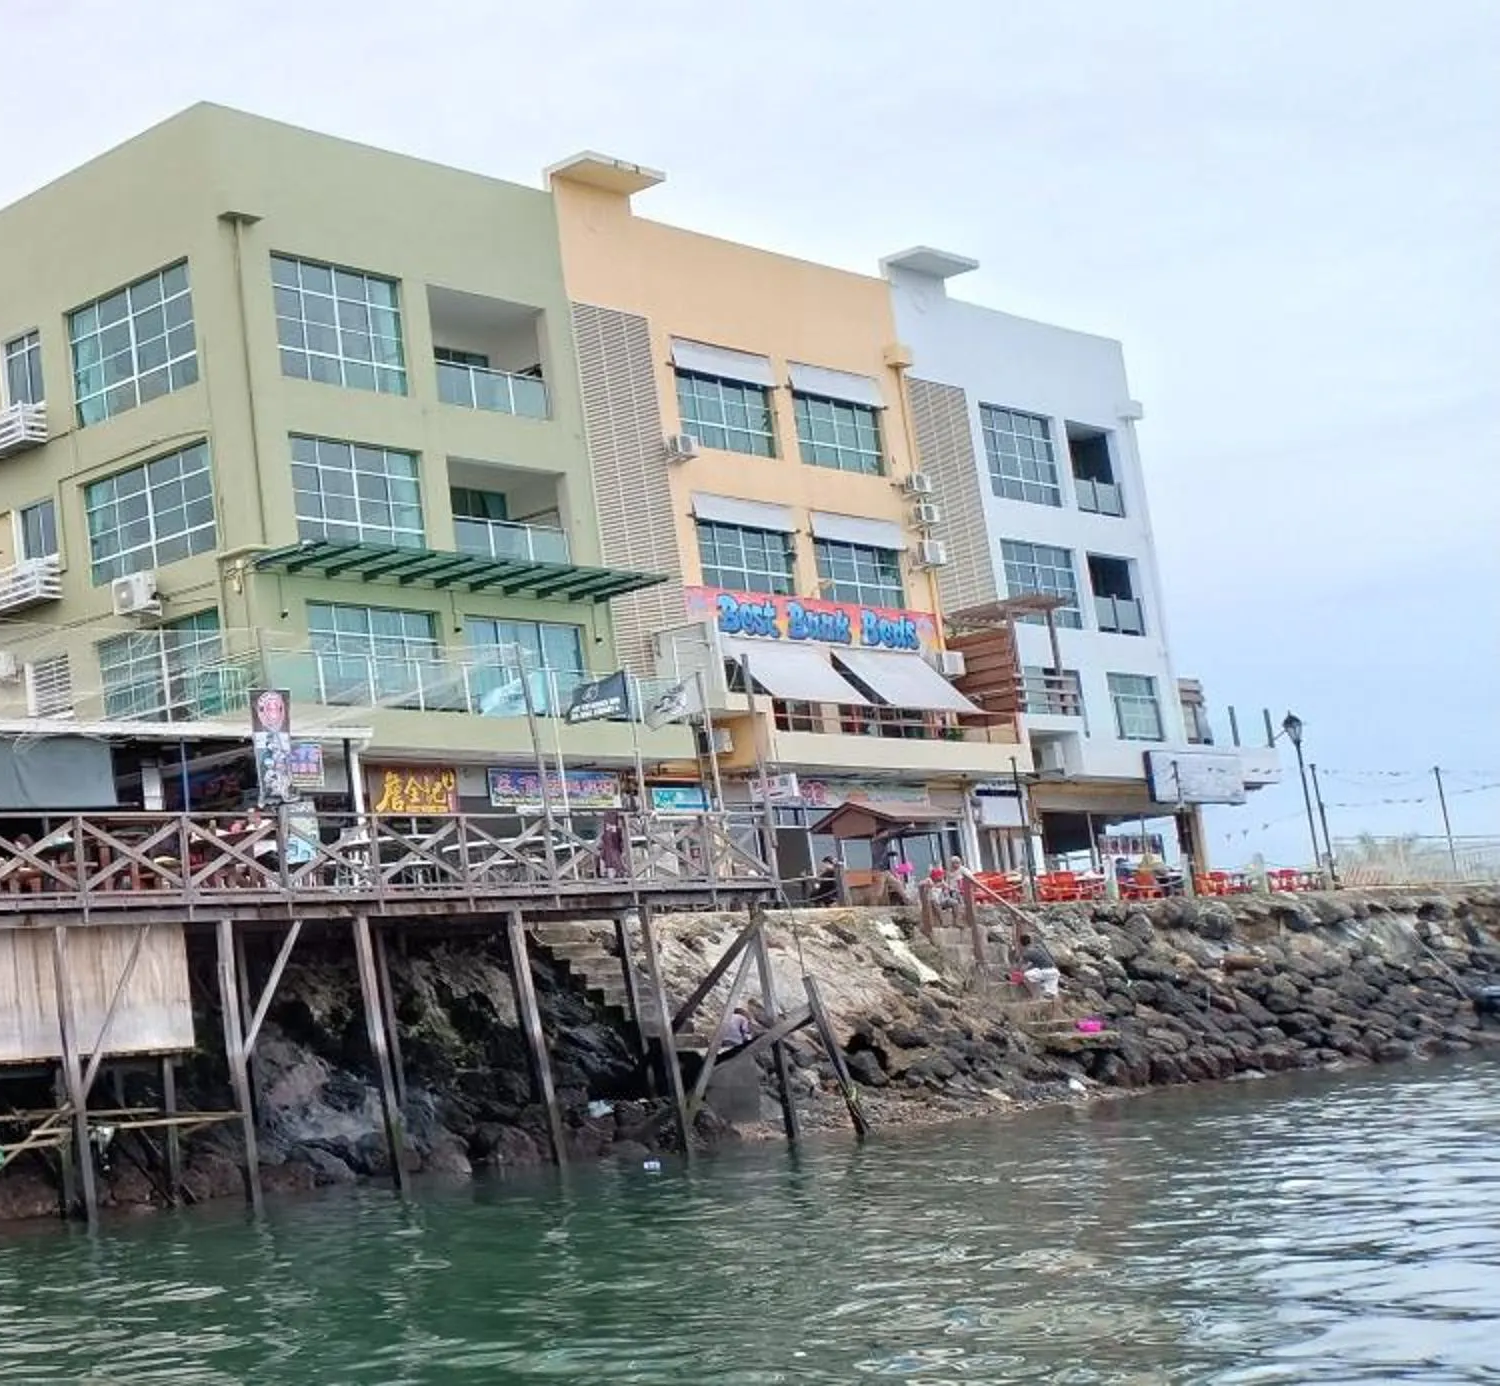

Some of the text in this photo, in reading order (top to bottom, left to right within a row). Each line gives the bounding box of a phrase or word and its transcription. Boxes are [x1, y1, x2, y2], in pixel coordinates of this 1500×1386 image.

[716, 592, 921, 651] Best Bunk Beds
